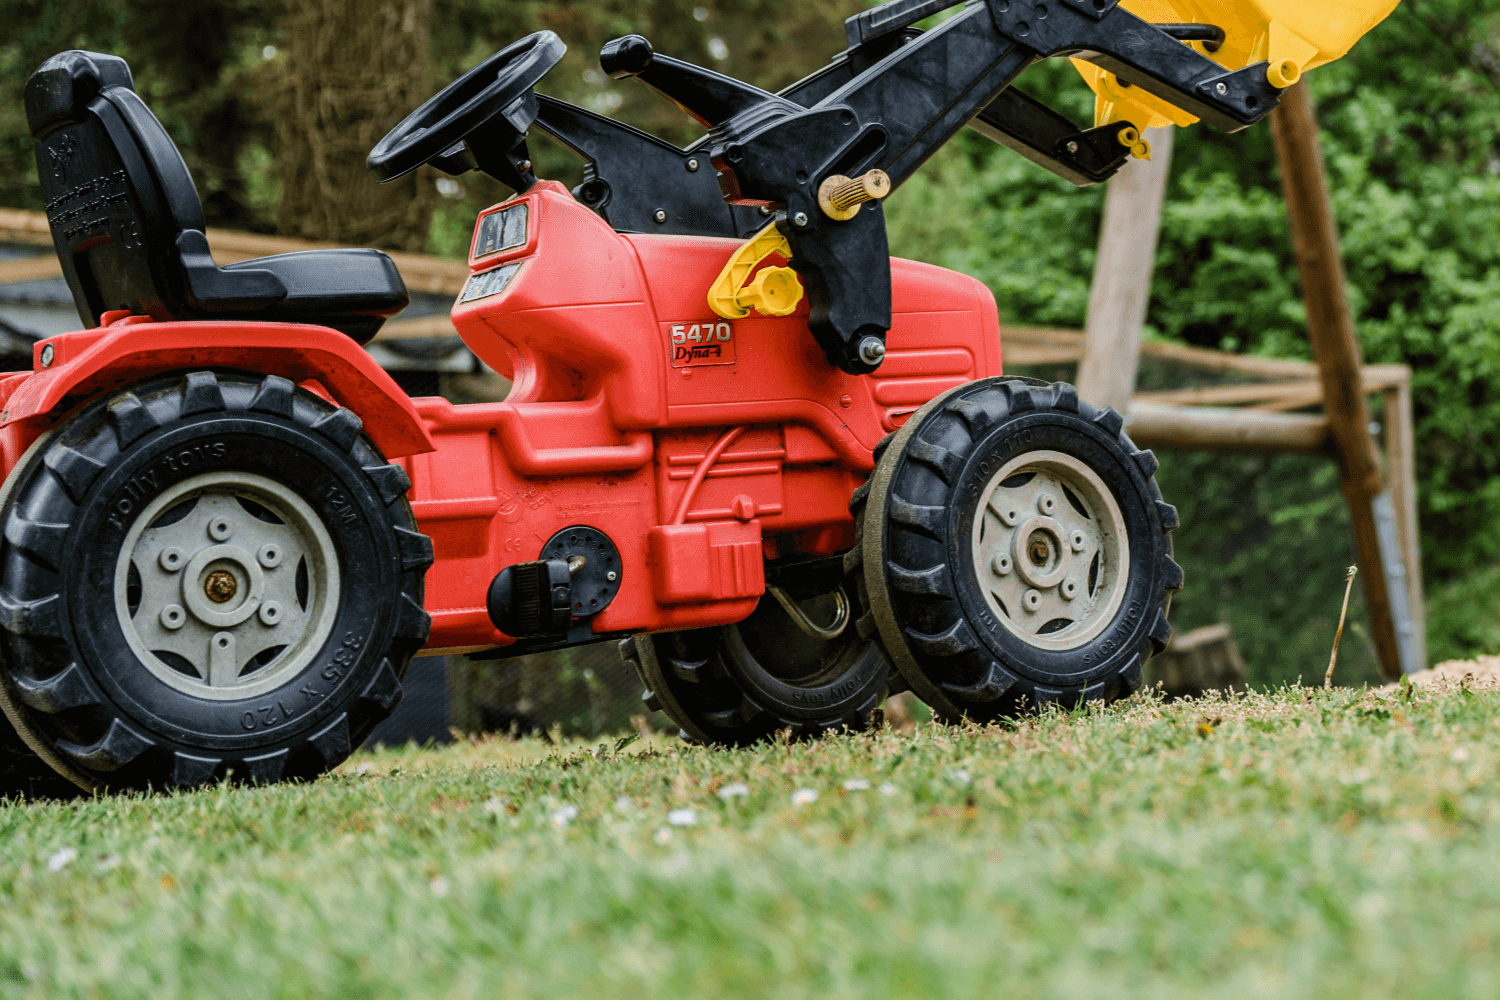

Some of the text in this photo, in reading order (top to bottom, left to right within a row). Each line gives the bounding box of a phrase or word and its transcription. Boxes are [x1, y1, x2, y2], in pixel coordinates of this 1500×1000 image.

[672, 322, 731, 344] 5470
[675, 345, 722, 363] Dyna-4
[109, 442, 226, 530] rolly toys
[240, 701, 295, 731] 120
